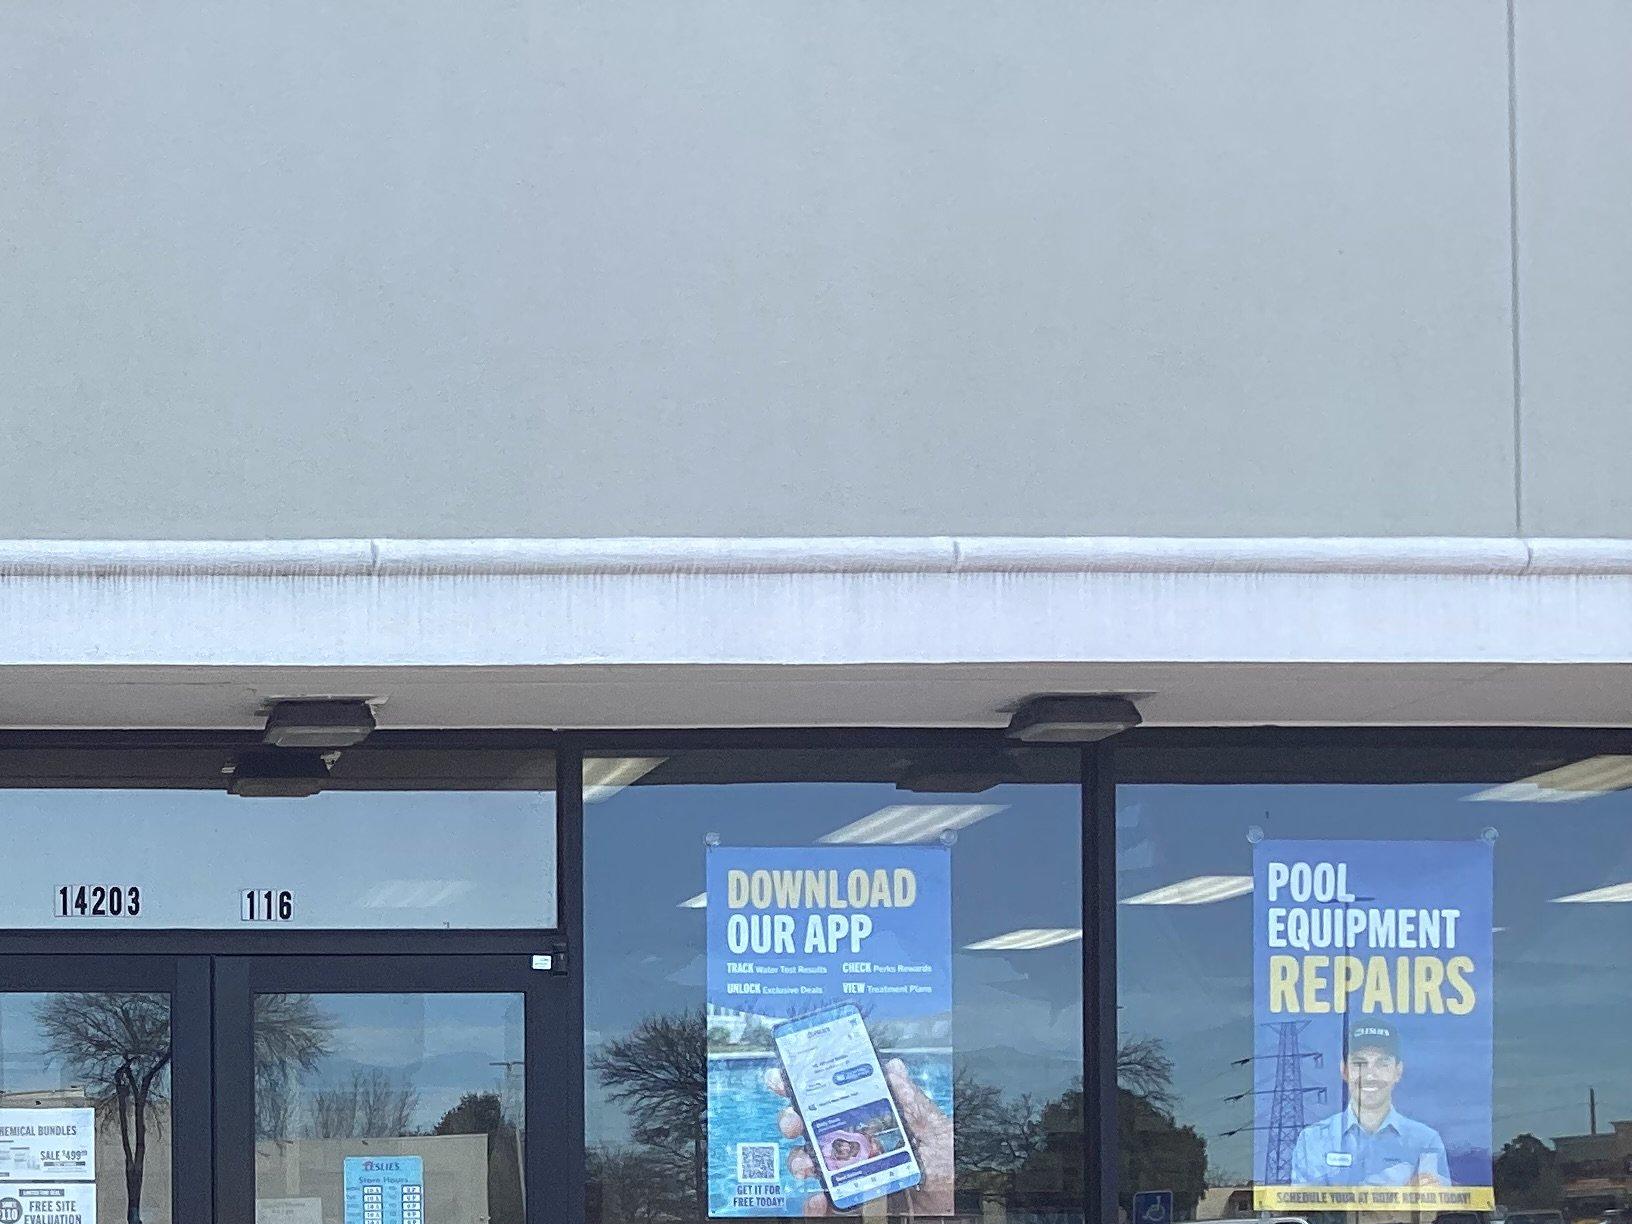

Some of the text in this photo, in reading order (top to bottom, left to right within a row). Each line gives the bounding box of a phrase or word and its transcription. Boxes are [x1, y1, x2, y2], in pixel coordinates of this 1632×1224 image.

[727, 868, 917, 909] DOWNLOAD
[1268, 862, 1355, 903] POOL
[59, 886, 140, 916] 14203
[247, 890, 292, 920] 116
[727, 914, 873, 954] OUR APP
[1268, 908, 1460, 951] EQUIPMENT
[727, 962, 827, 974] TRACK Water Test Results
[842, 962, 932, 973] CHECK Perks Rewards
[727, 983, 823, 994] UNLOCK Exclusive Deals
[842, 982, 932, 994] VIEW Treatment Plans
[1269, 954, 1477, 1015] REPAIRS
[38, 1125, 77, 1136] BUNDLES
[40, 1151, 60, 1160] SALE
[737, 1185, 781, 1195] GET IT FOR
[733, 1197, 754, 1207] FREE
[1276, 1192, 1327, 1204] SCHEDULE
[1403, 1192, 1437, 1204] REPAIR
[29, 1200, 76, 1212] FREE SITE
